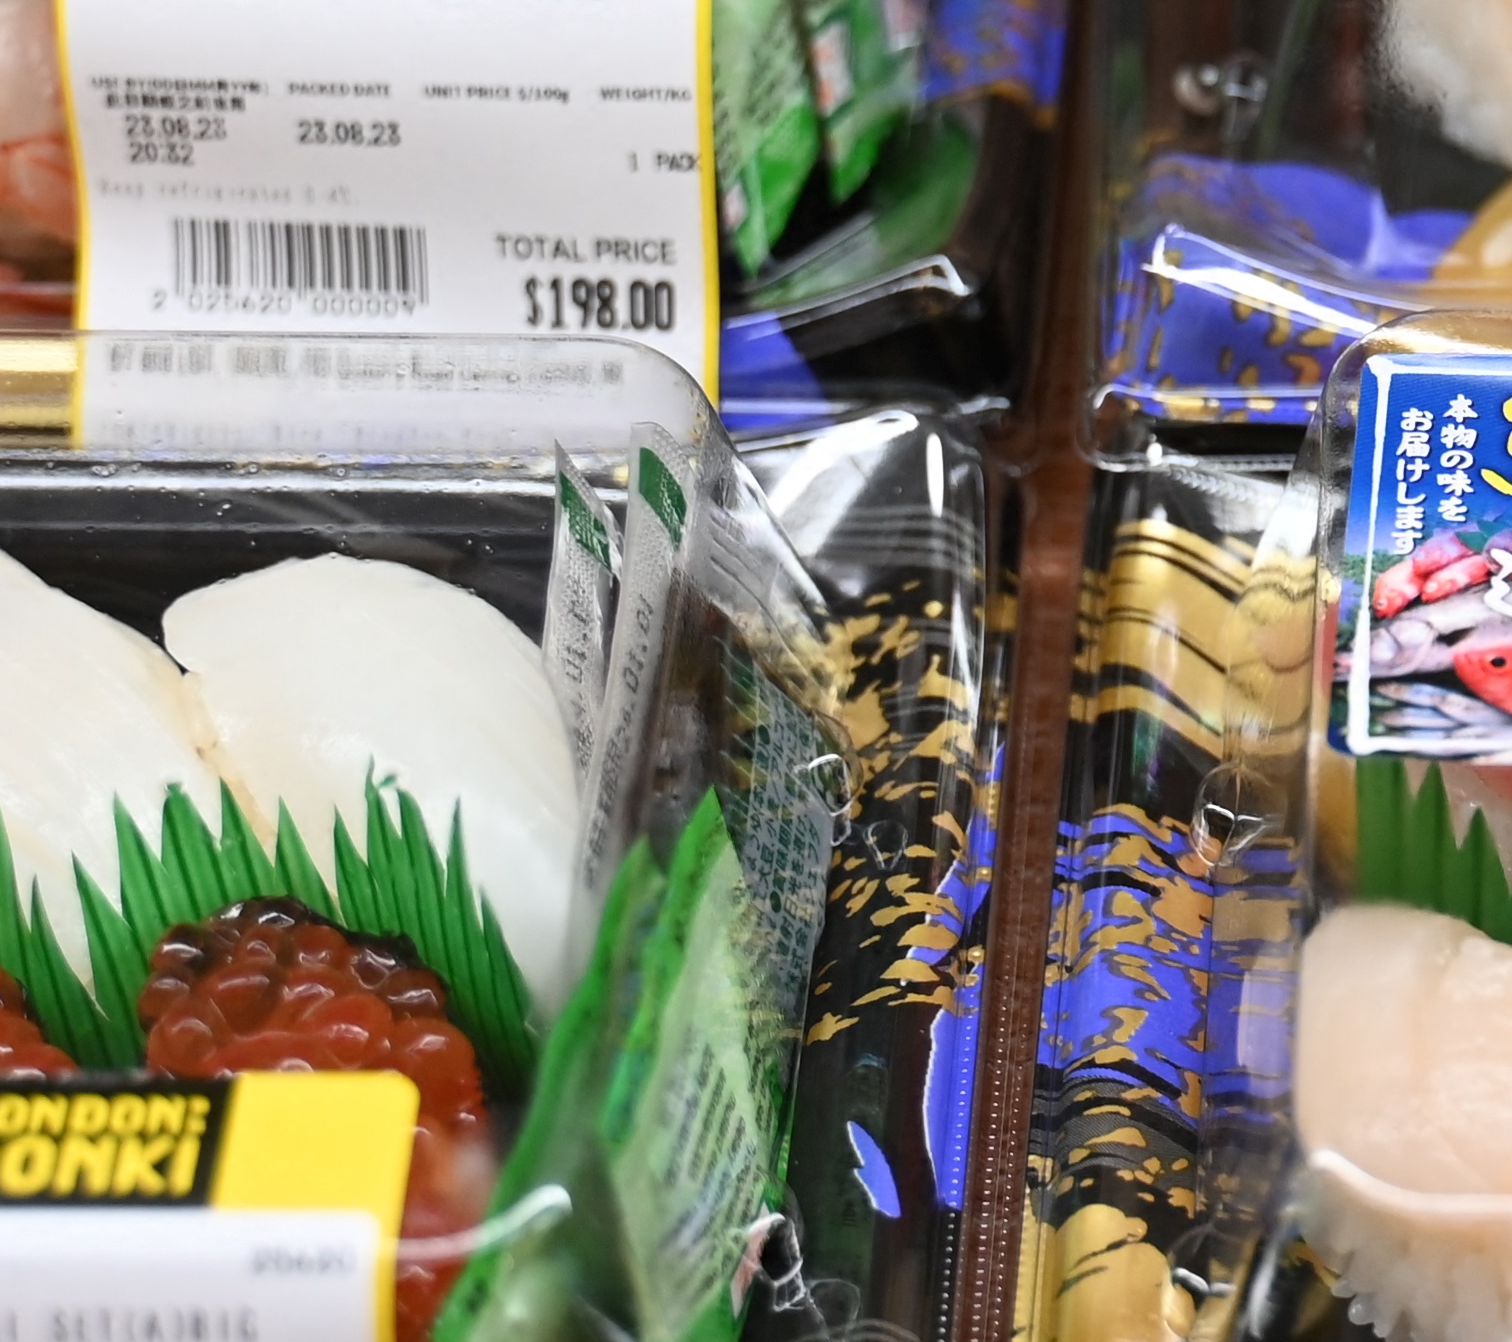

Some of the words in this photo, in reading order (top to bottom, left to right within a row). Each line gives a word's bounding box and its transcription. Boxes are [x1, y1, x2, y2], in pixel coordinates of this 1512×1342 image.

[125, 114, 227, 140] 23.08.23
[298, 120, 402, 147] 23.08.23
[496, 233, 587, 262] TOTAL
[595, 237, 677, 264] PRICE
[525, 276, 676, 331] $198.00
[1437, 394, 1479, 523] 本物の味を
[1391, 407, 1434, 556] お届けします
